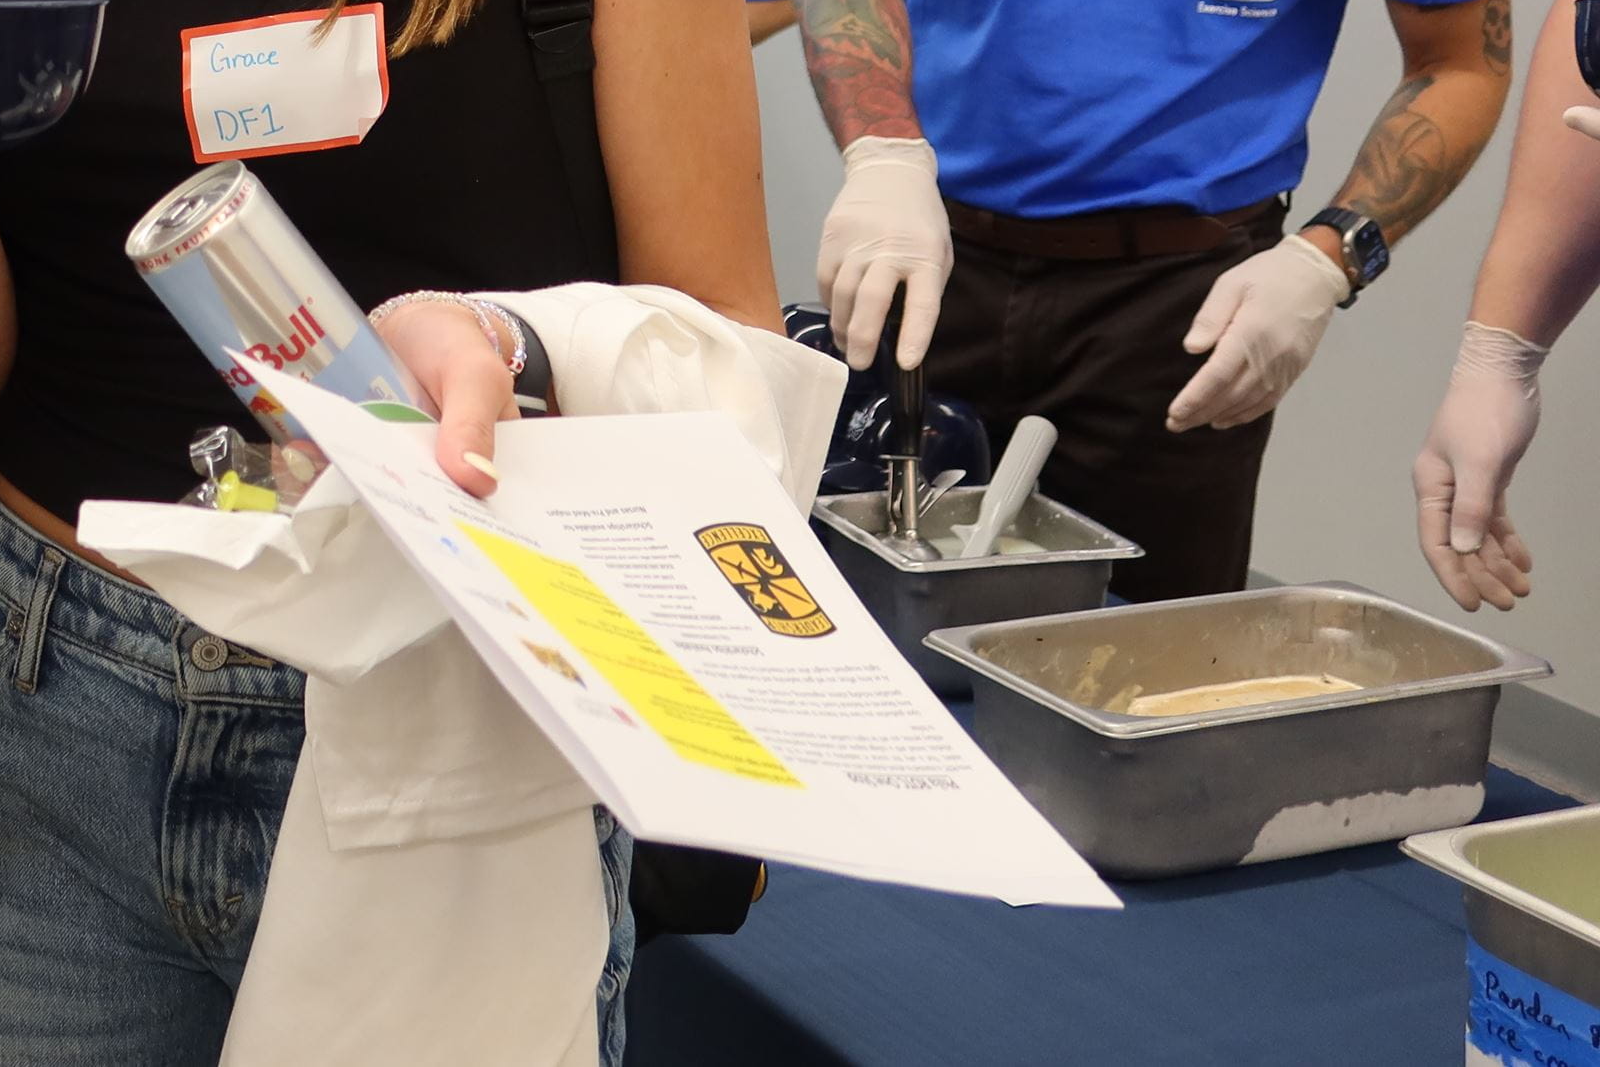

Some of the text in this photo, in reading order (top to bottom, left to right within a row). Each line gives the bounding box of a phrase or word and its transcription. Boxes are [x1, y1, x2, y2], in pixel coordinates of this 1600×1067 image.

[1197, 1, 1278, 18] Exercise Science
[210, 42, 280, 74] Grace
[213, 103, 285, 142] DF1
[175, 226, 210, 256] FRUIT
[246, 305, 326, 372] Bull
[699, 526, 767, 548] EXCELLENCE
[764, 614, 828, 637] LEADERSHIP
